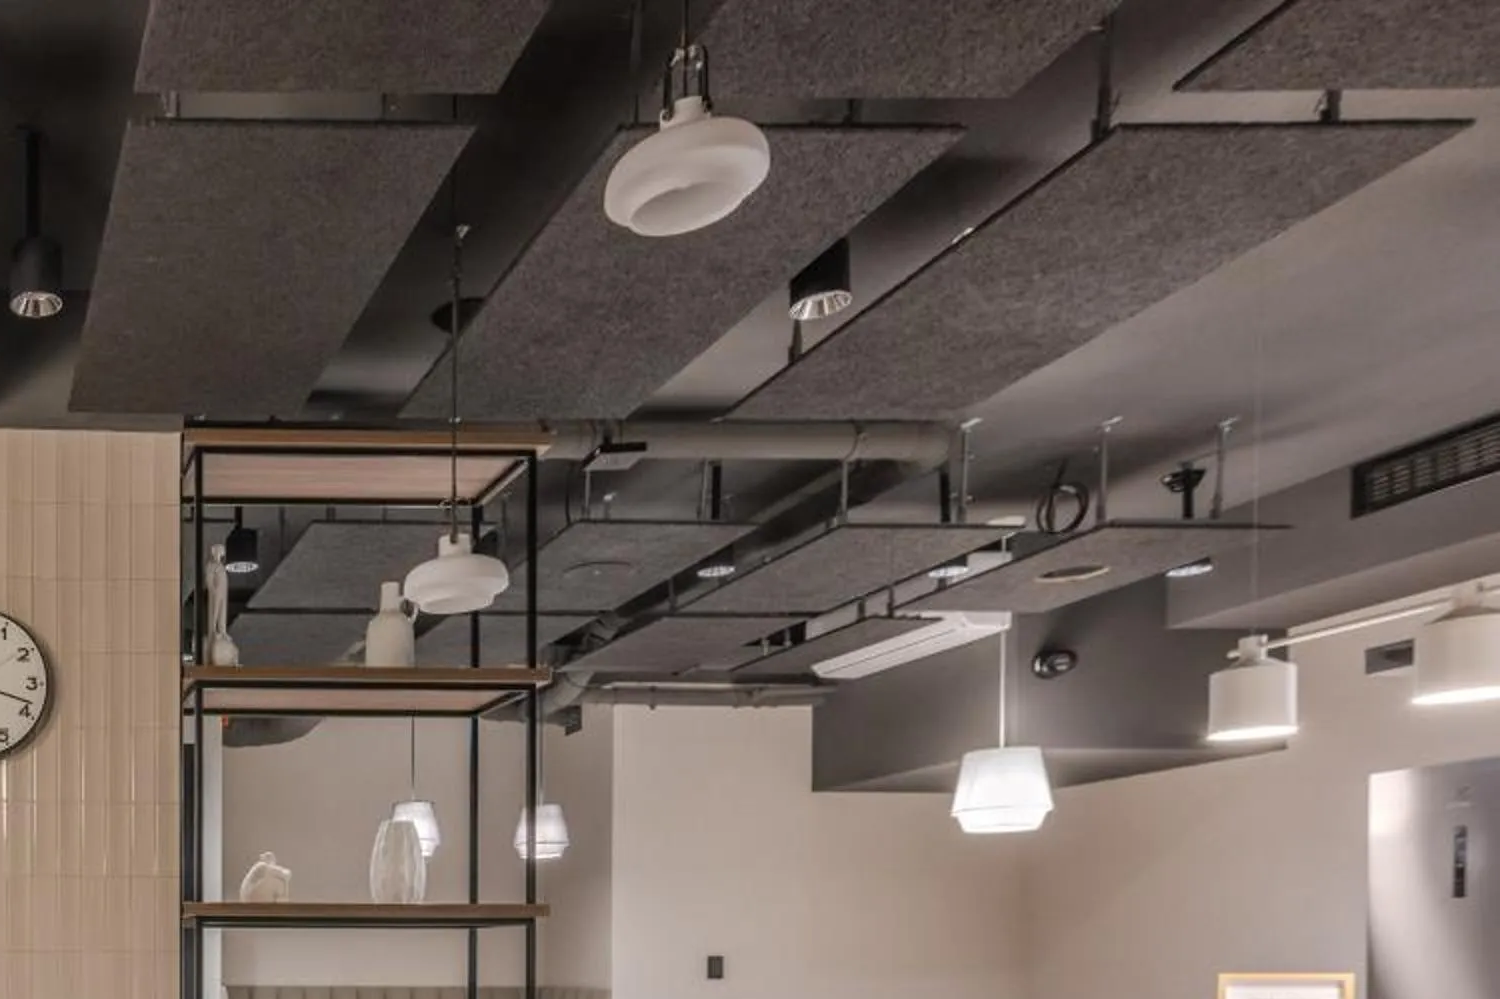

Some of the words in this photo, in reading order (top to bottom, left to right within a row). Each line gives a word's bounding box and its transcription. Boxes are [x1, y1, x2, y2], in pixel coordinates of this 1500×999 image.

[1, 627, 8, 641] 1
[16, 647, 30, 663] 2
[25, 676, 38, 691] 3
[18, 704, 31, 719] 4
